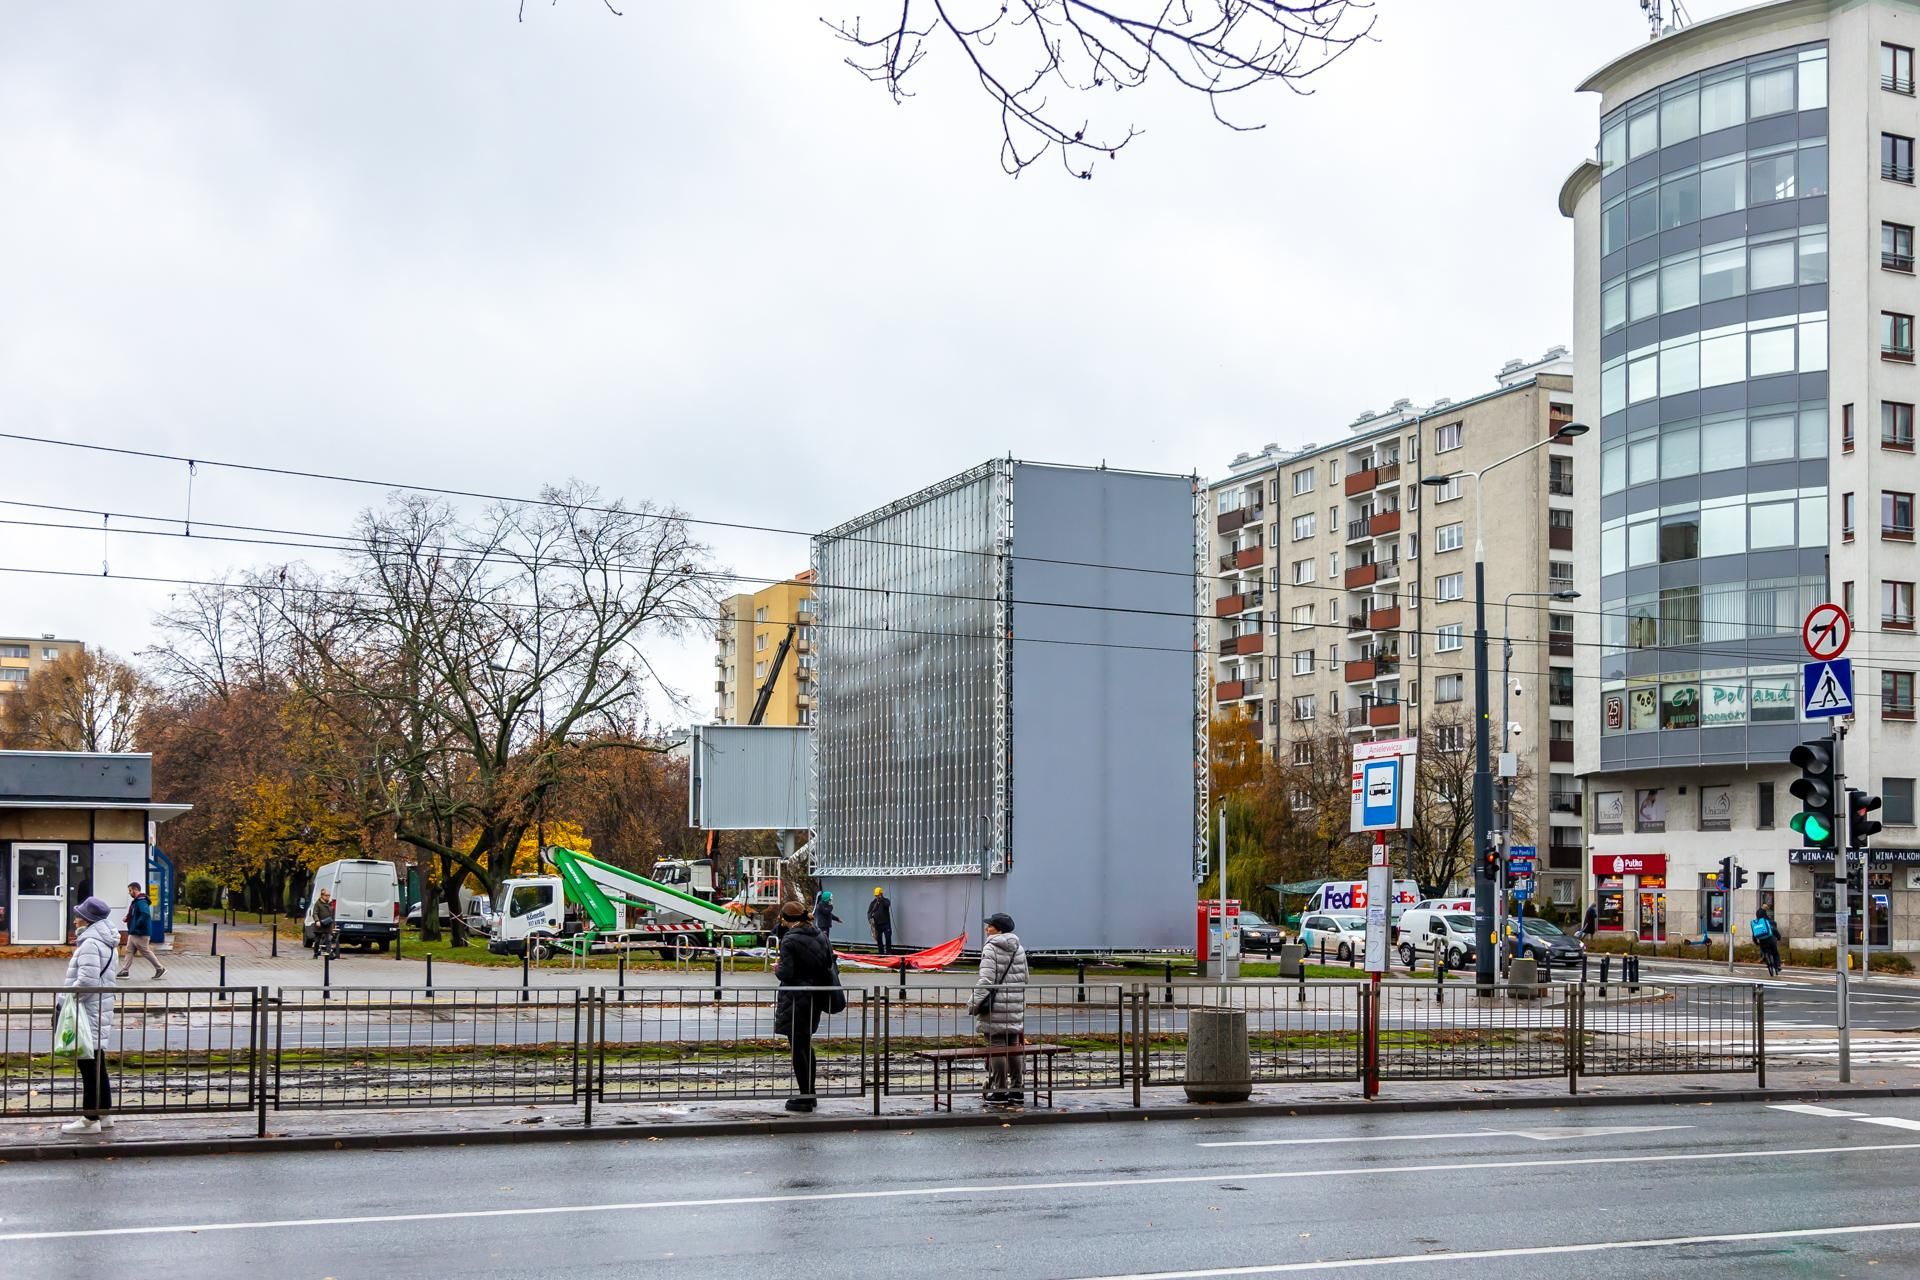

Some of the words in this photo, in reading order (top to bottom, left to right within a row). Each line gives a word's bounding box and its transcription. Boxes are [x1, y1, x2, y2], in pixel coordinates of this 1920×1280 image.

[1608, 701, 1618, 716] 25
[1670, 714, 1696, 723] BIURO
[1802, 852, 1822, 861] WINA
[1876, 851, 1894, 860] WINA
[1625, 859, 1643, 867] Putka
[1391, 891, 1416, 904] edEx
